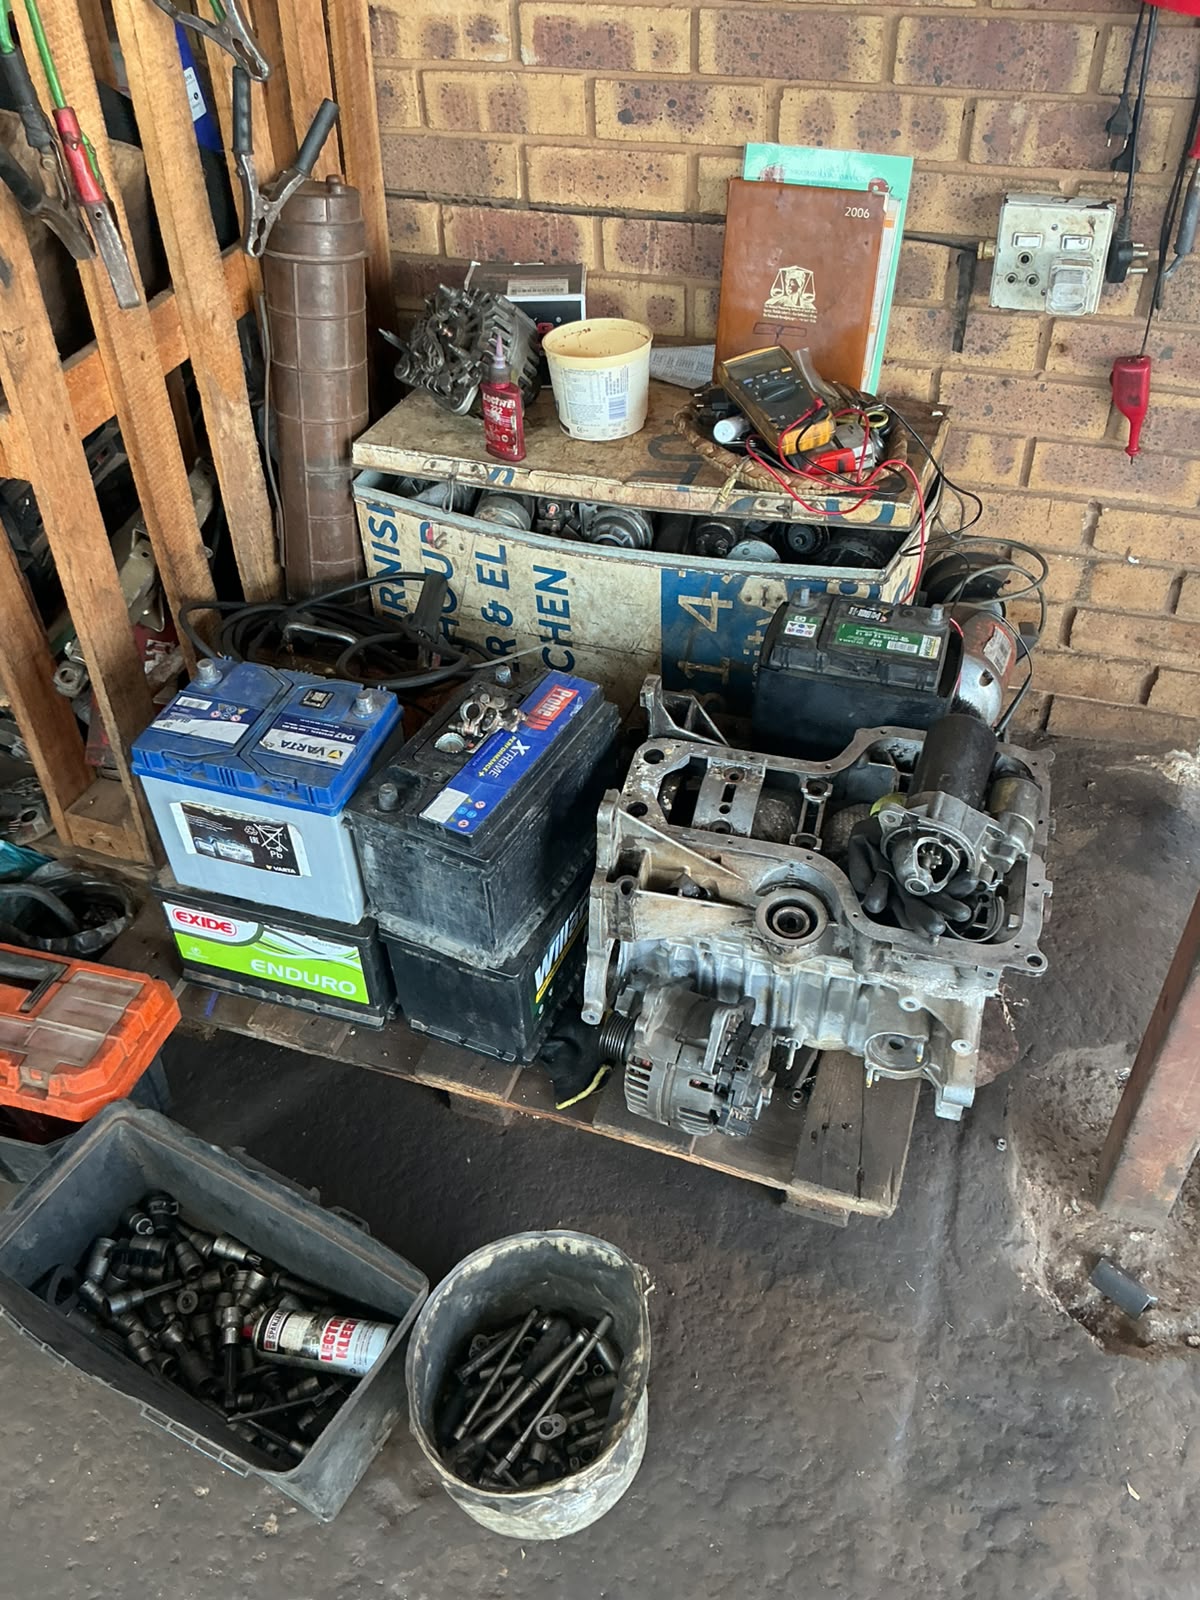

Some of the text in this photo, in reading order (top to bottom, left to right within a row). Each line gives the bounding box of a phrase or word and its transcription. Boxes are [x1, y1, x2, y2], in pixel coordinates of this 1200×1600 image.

[844, 206, 870, 219] 2006
[474, 544, 511, 591] EL
[481, 600, 514, 628] &
[532, 564, 576, 673] CHEN
[537, 688, 574, 718] Probe
[280, 739, 325, 757] VARTA
[334, 732, 356, 742] D47
[488, 739, 531, 779] XTREME
[270, 849, 284, 860] Pb
[273, 865, 297, 875] VARTA
[175, 910, 233, 934] EXIDE
[251, 958, 357, 996] ENDURO
